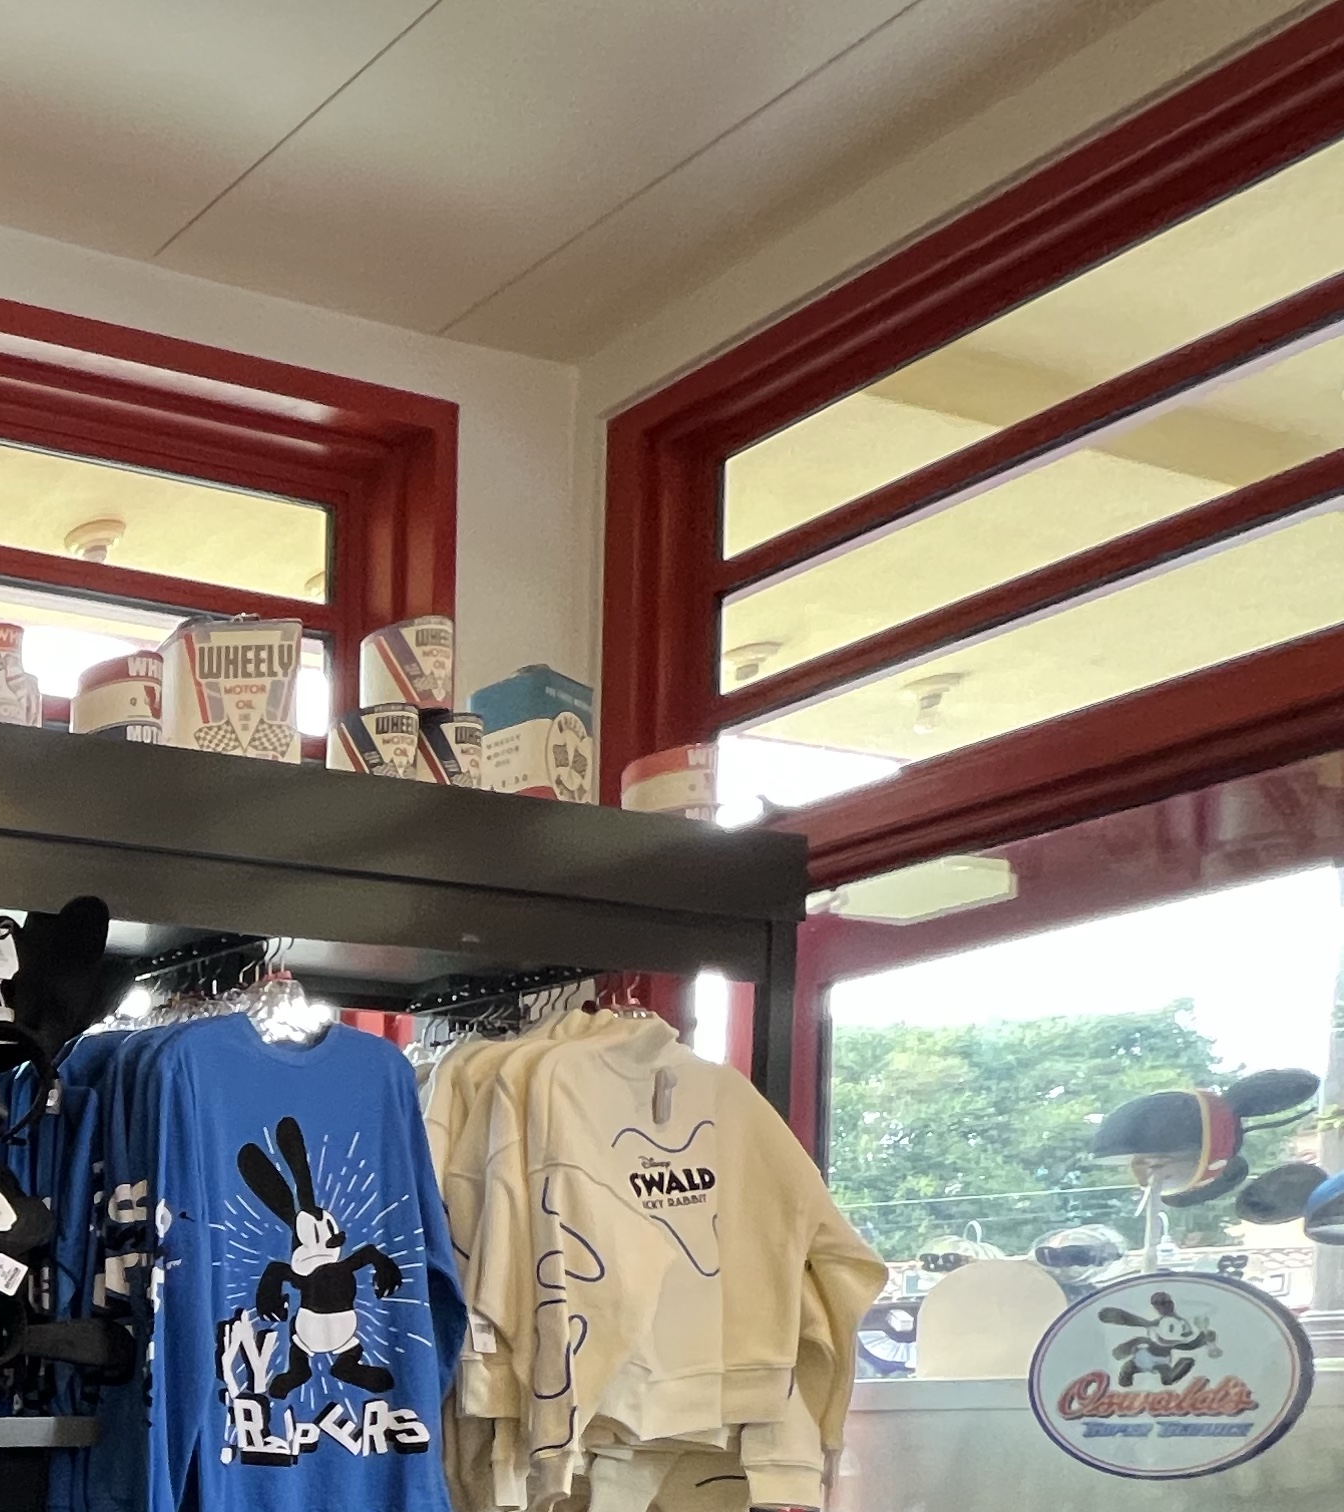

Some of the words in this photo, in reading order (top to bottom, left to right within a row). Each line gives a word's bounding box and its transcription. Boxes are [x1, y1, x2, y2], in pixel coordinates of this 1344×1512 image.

[197, 643, 295, 680] WHEELY
[223, 683, 267, 696] MOTOR
[628, 1167, 716, 1199] SWALD
